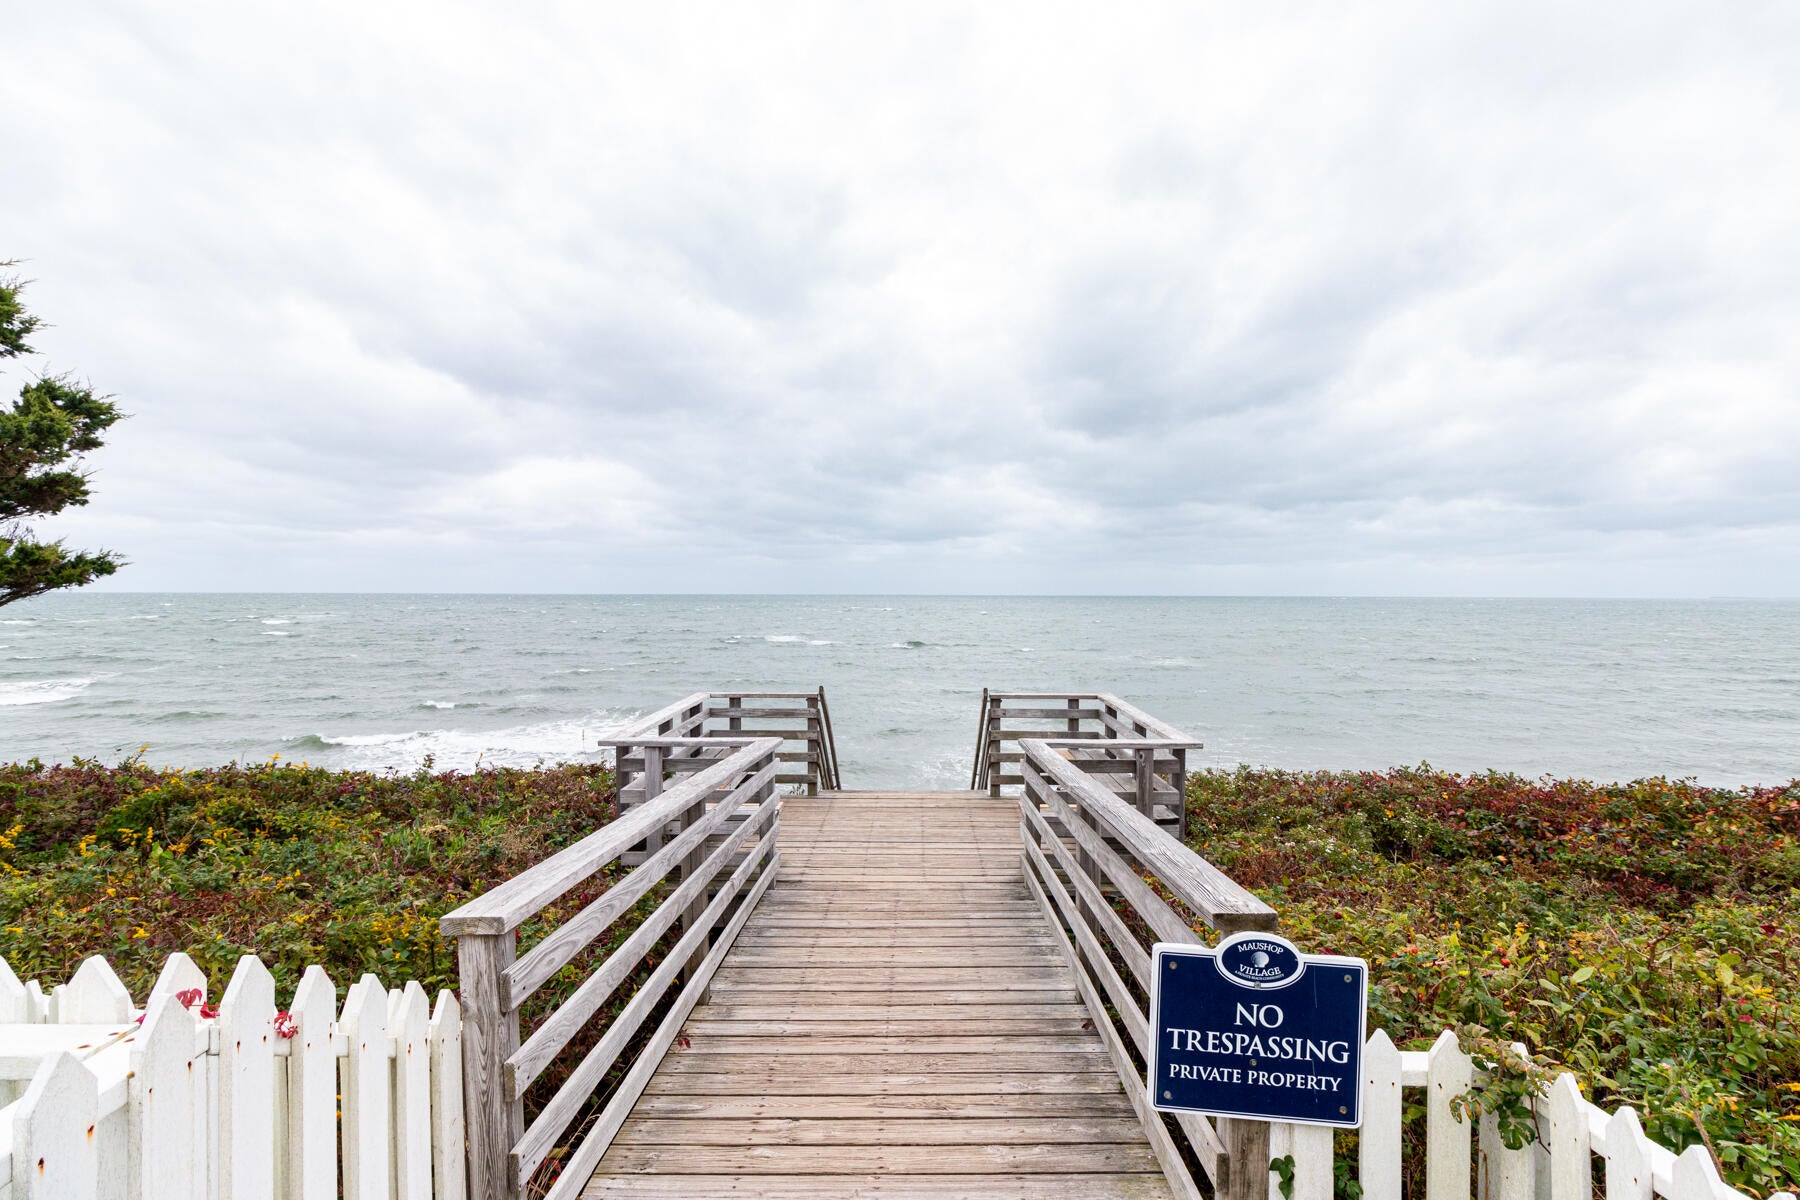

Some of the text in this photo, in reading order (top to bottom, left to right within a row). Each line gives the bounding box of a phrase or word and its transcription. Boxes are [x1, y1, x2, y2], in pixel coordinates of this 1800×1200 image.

[1237, 942, 1284, 955] MAUSHOP
[1239, 964, 1281, 976] VILLAGE
[1234, 1002, 1284, 1028] NO
[1166, 1028, 1350, 1064] TRESPASSING
[1169, 1063, 1343, 1092] PRIVATE PROPERTY
